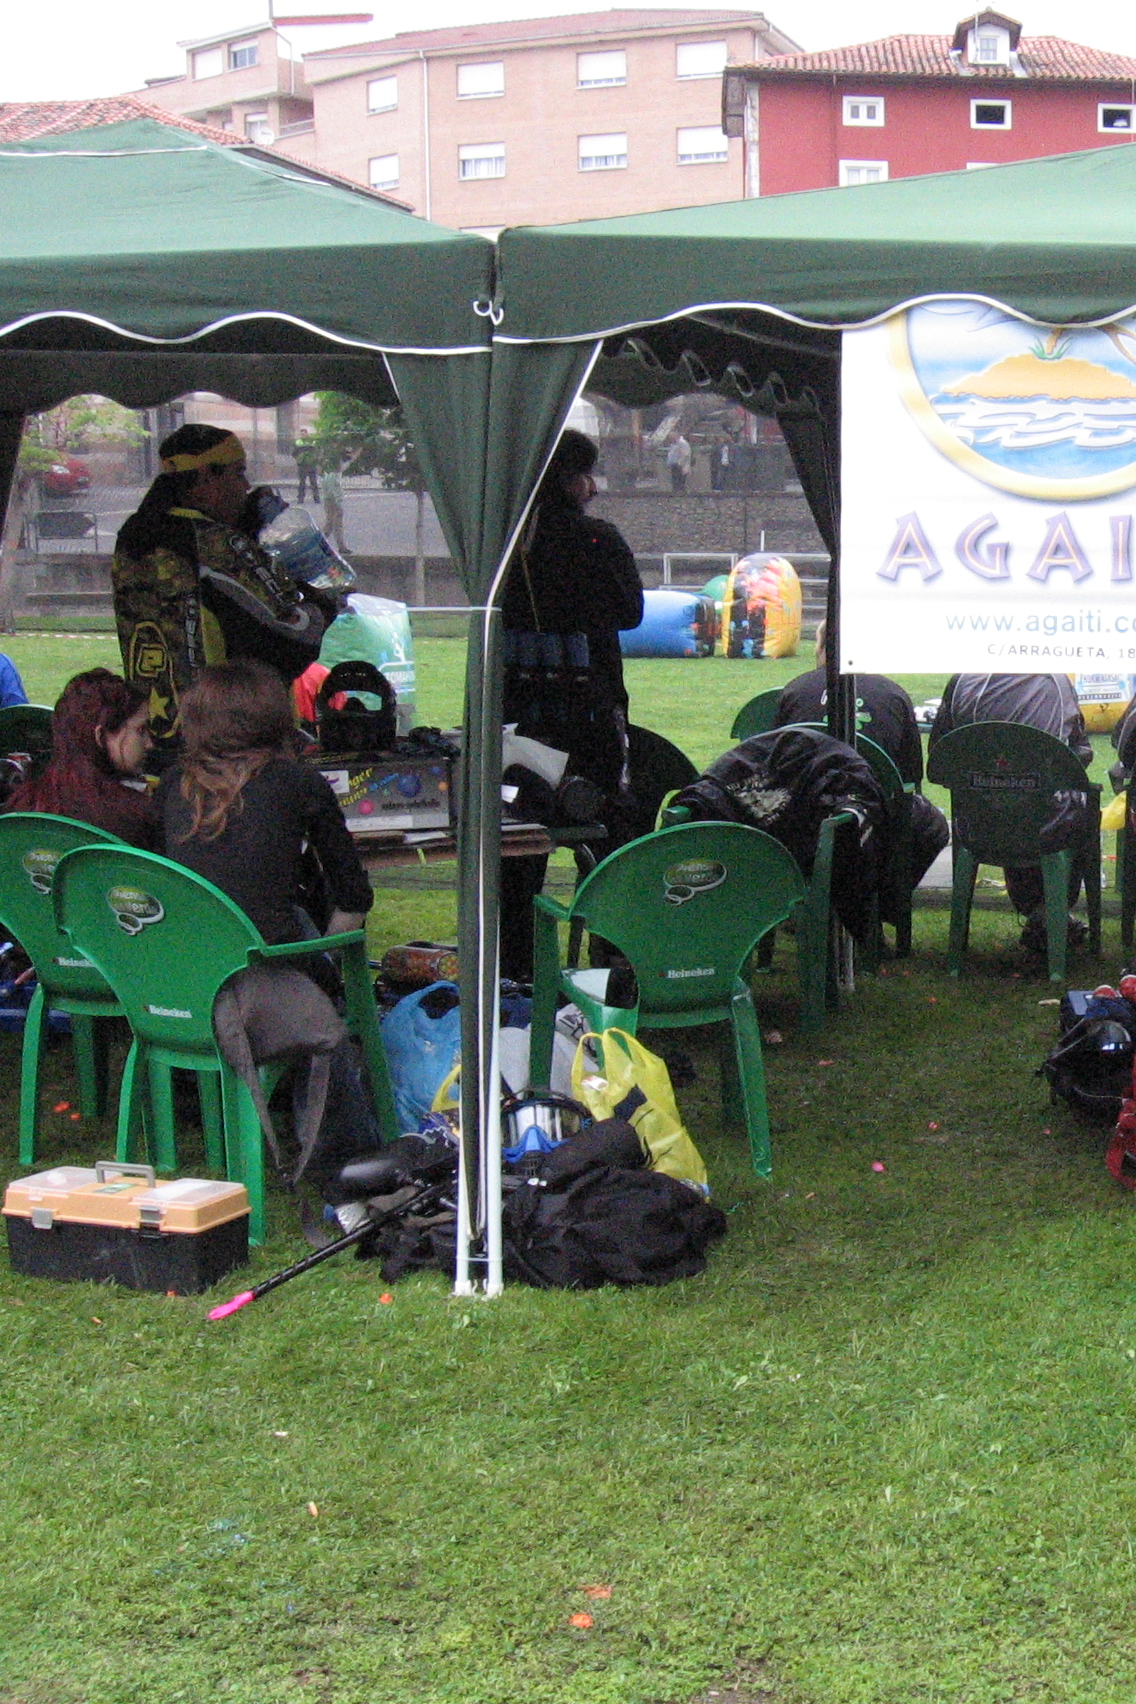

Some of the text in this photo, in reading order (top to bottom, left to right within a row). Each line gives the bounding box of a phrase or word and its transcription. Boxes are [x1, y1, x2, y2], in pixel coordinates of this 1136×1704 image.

[1119, 648, 1136, 659] 18
[667, 967, 716, 979] Heineken
[148, 1004, 193, 1019] Heineken
